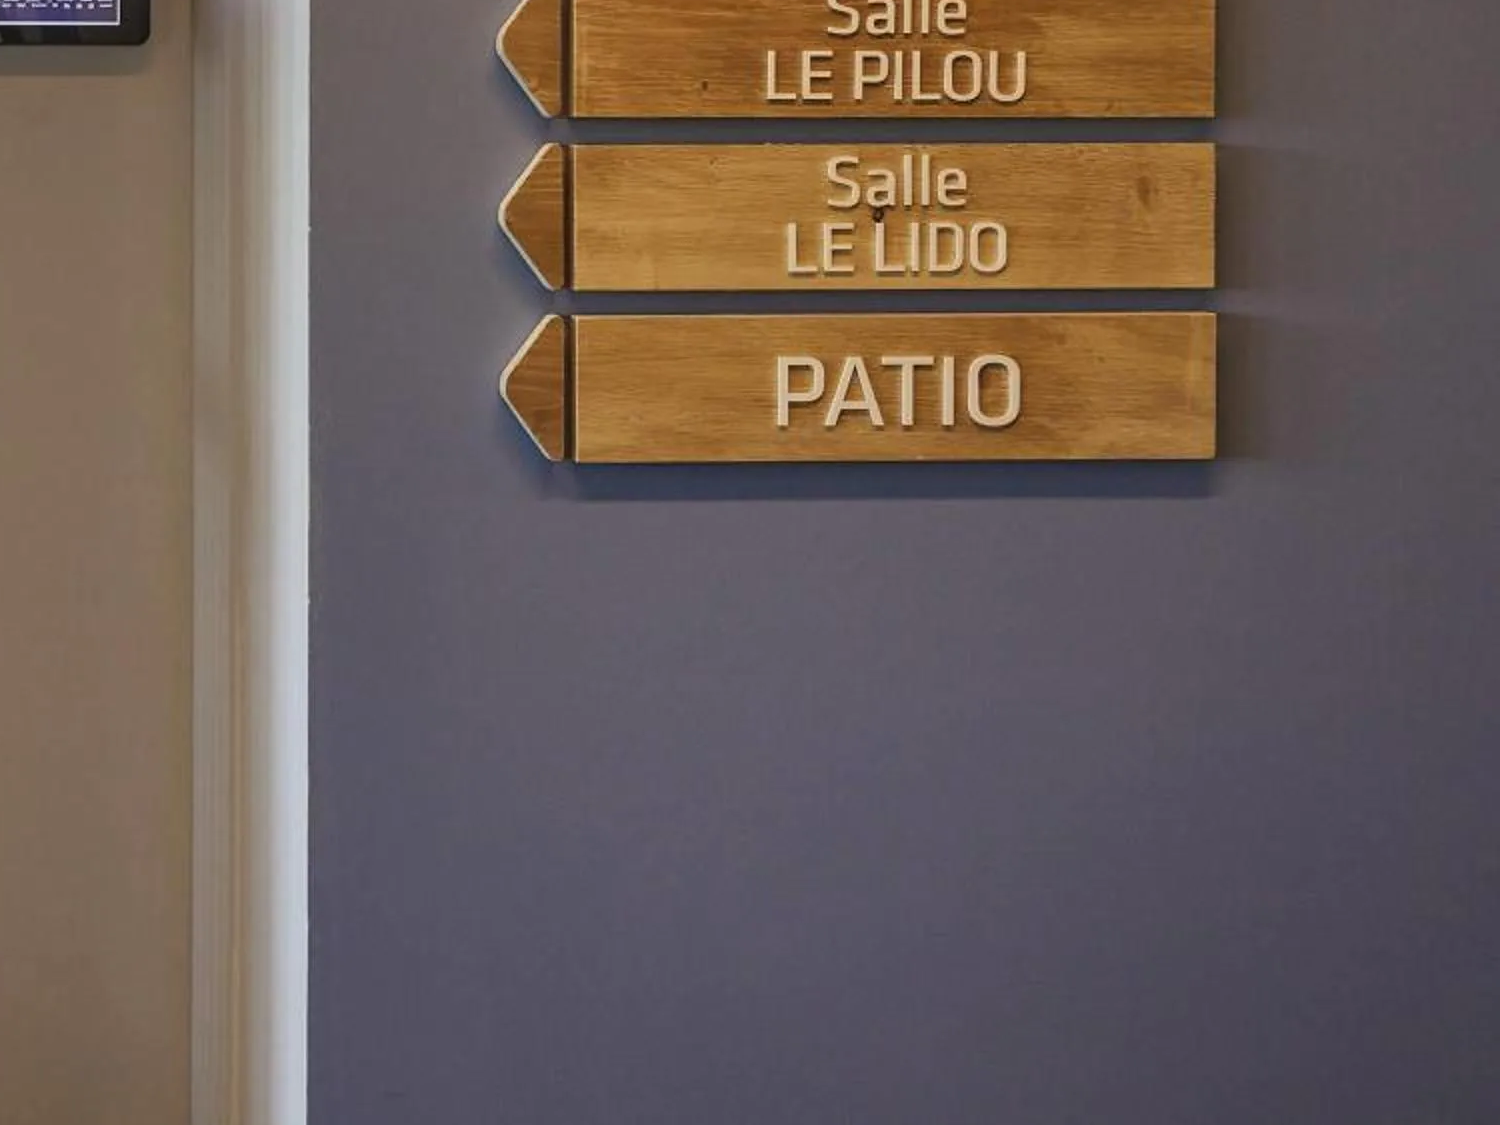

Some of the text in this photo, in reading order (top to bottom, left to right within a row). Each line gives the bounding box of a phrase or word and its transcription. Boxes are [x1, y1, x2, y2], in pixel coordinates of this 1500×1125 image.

[765, 50, 1027, 103] LE PILOU
[826, 155, 968, 209] Salle
[786, 221, 1009, 275] LE LIDO
[776, 353, 1022, 429] PATIO
